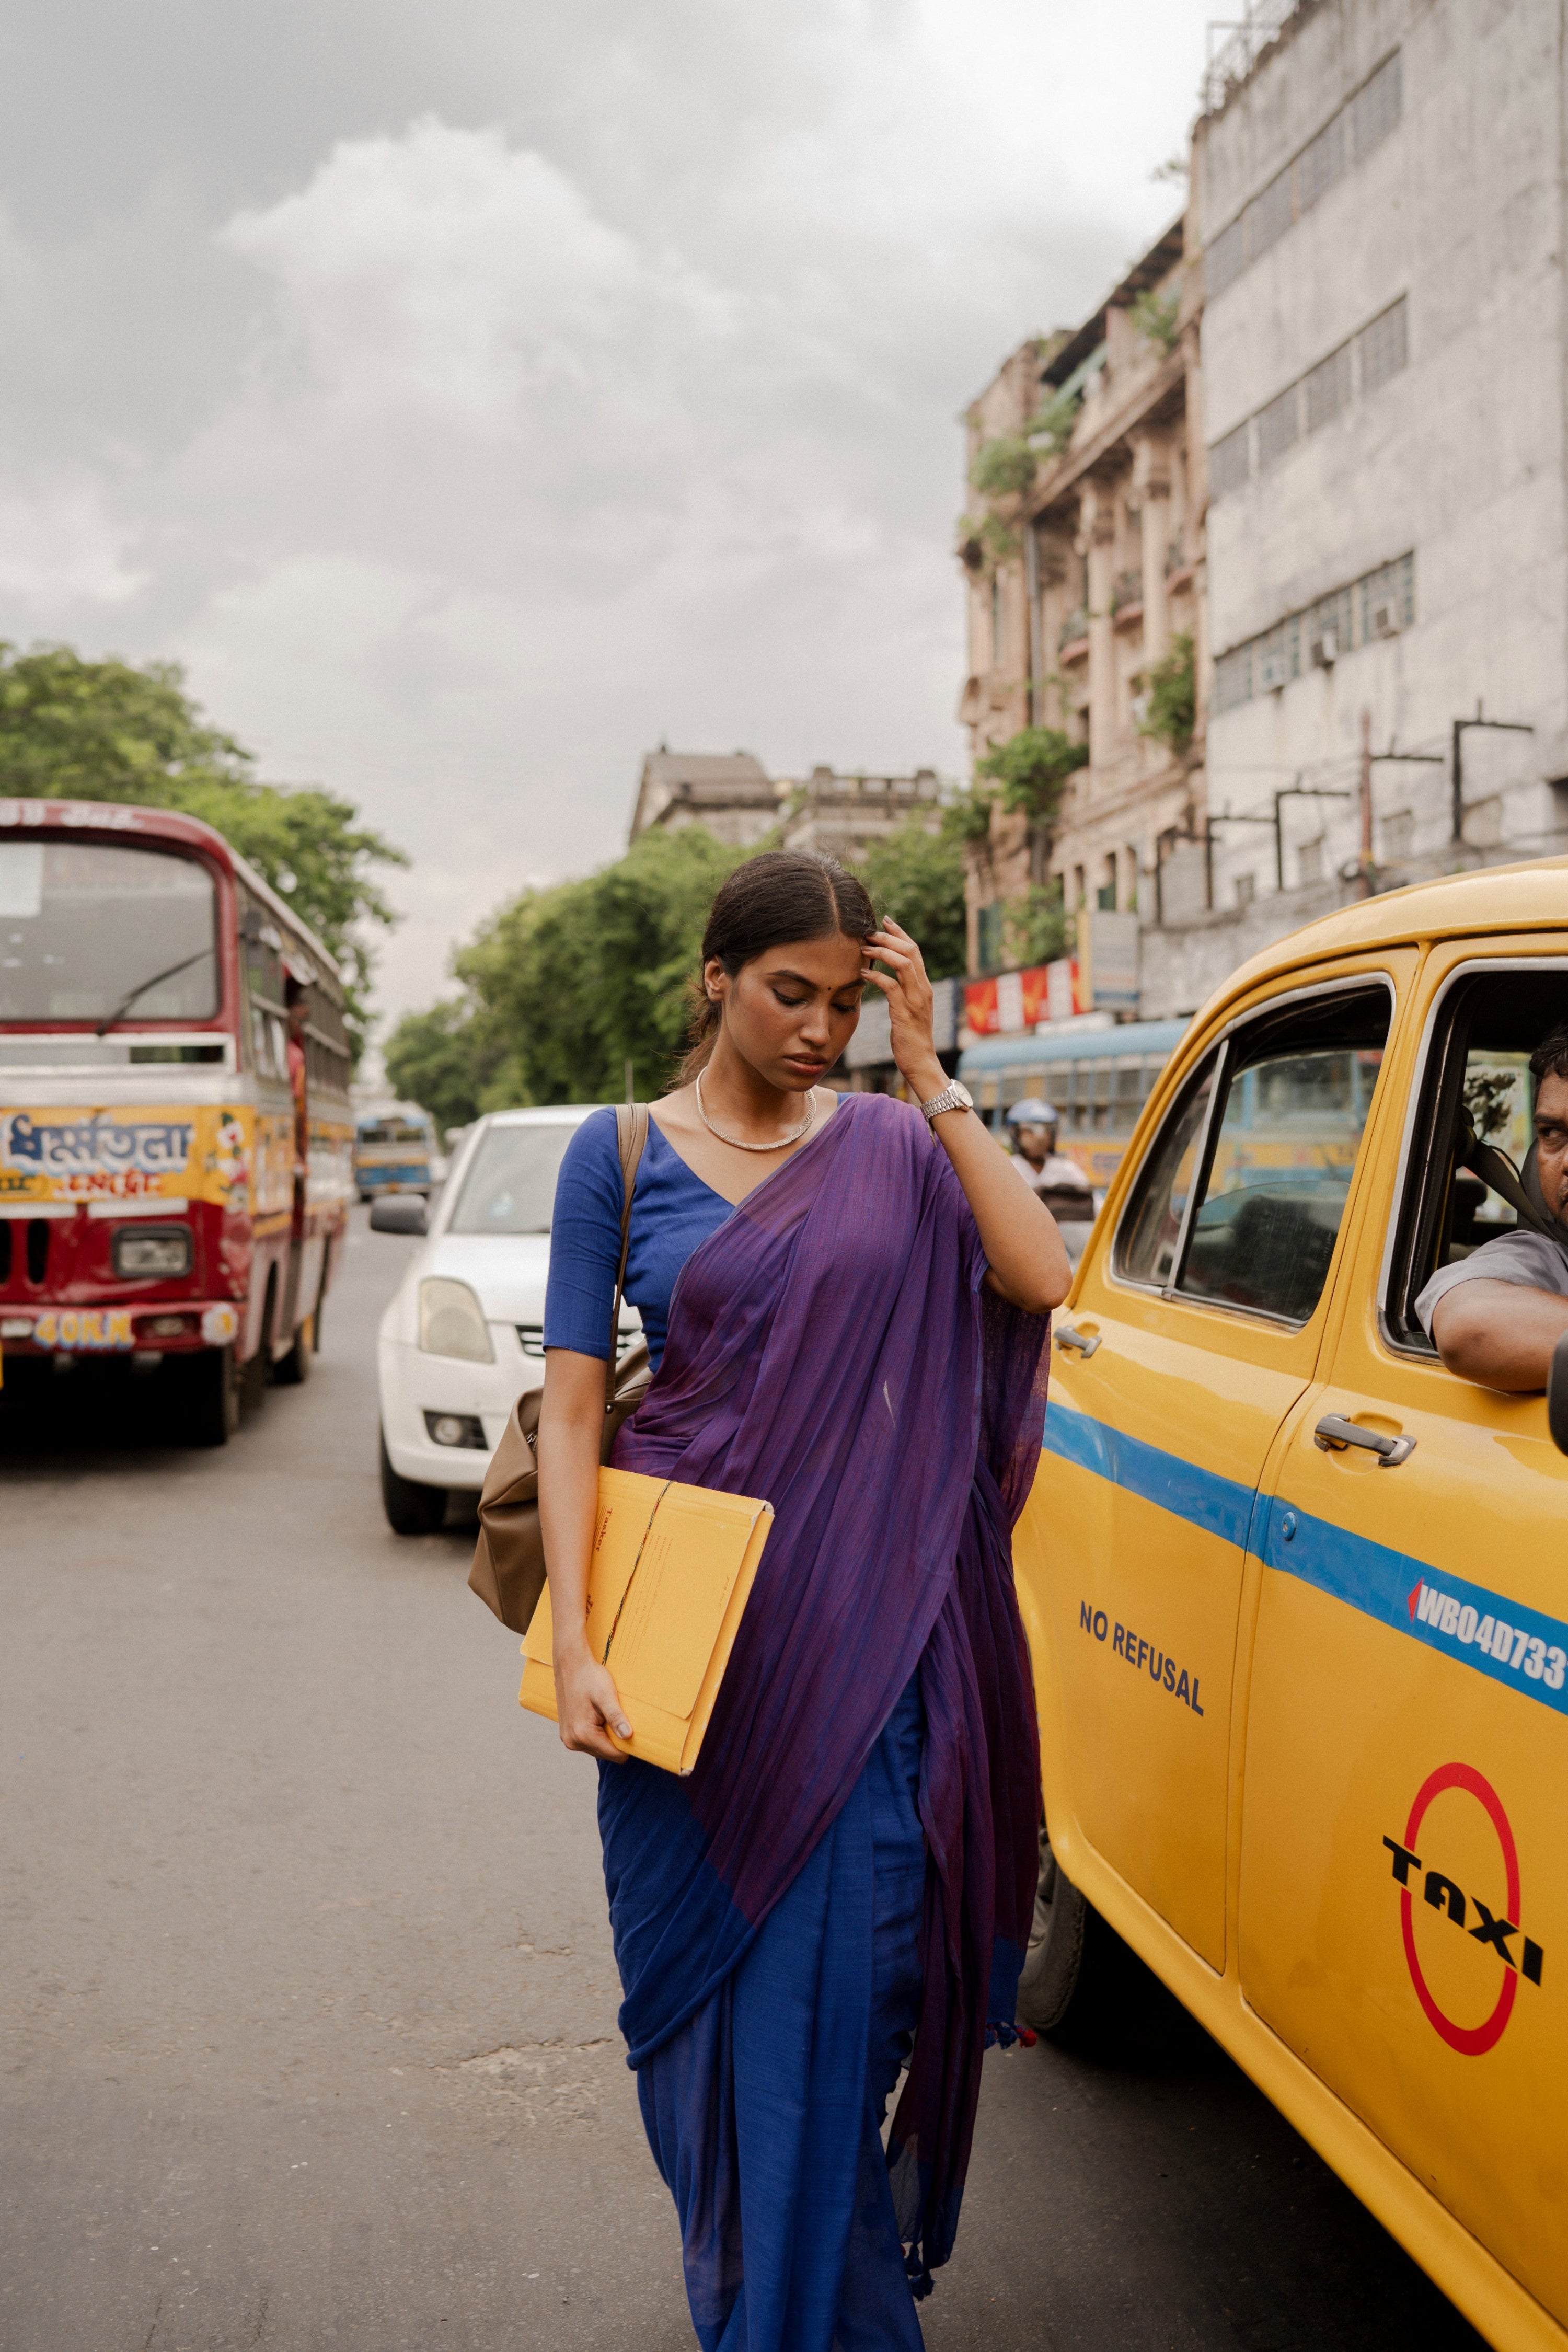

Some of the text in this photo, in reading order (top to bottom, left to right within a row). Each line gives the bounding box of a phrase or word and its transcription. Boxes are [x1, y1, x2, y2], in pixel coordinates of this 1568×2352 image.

[596, 1508, 613, 1552] Tasker
[658, 1537, 667, 1561] Subject
[1080, 1600, 1204, 1717] NO REFUSAL
[1417, 1584, 1568, 1690] WB04D733
[1383, 1835, 1543, 1987] TAXI
